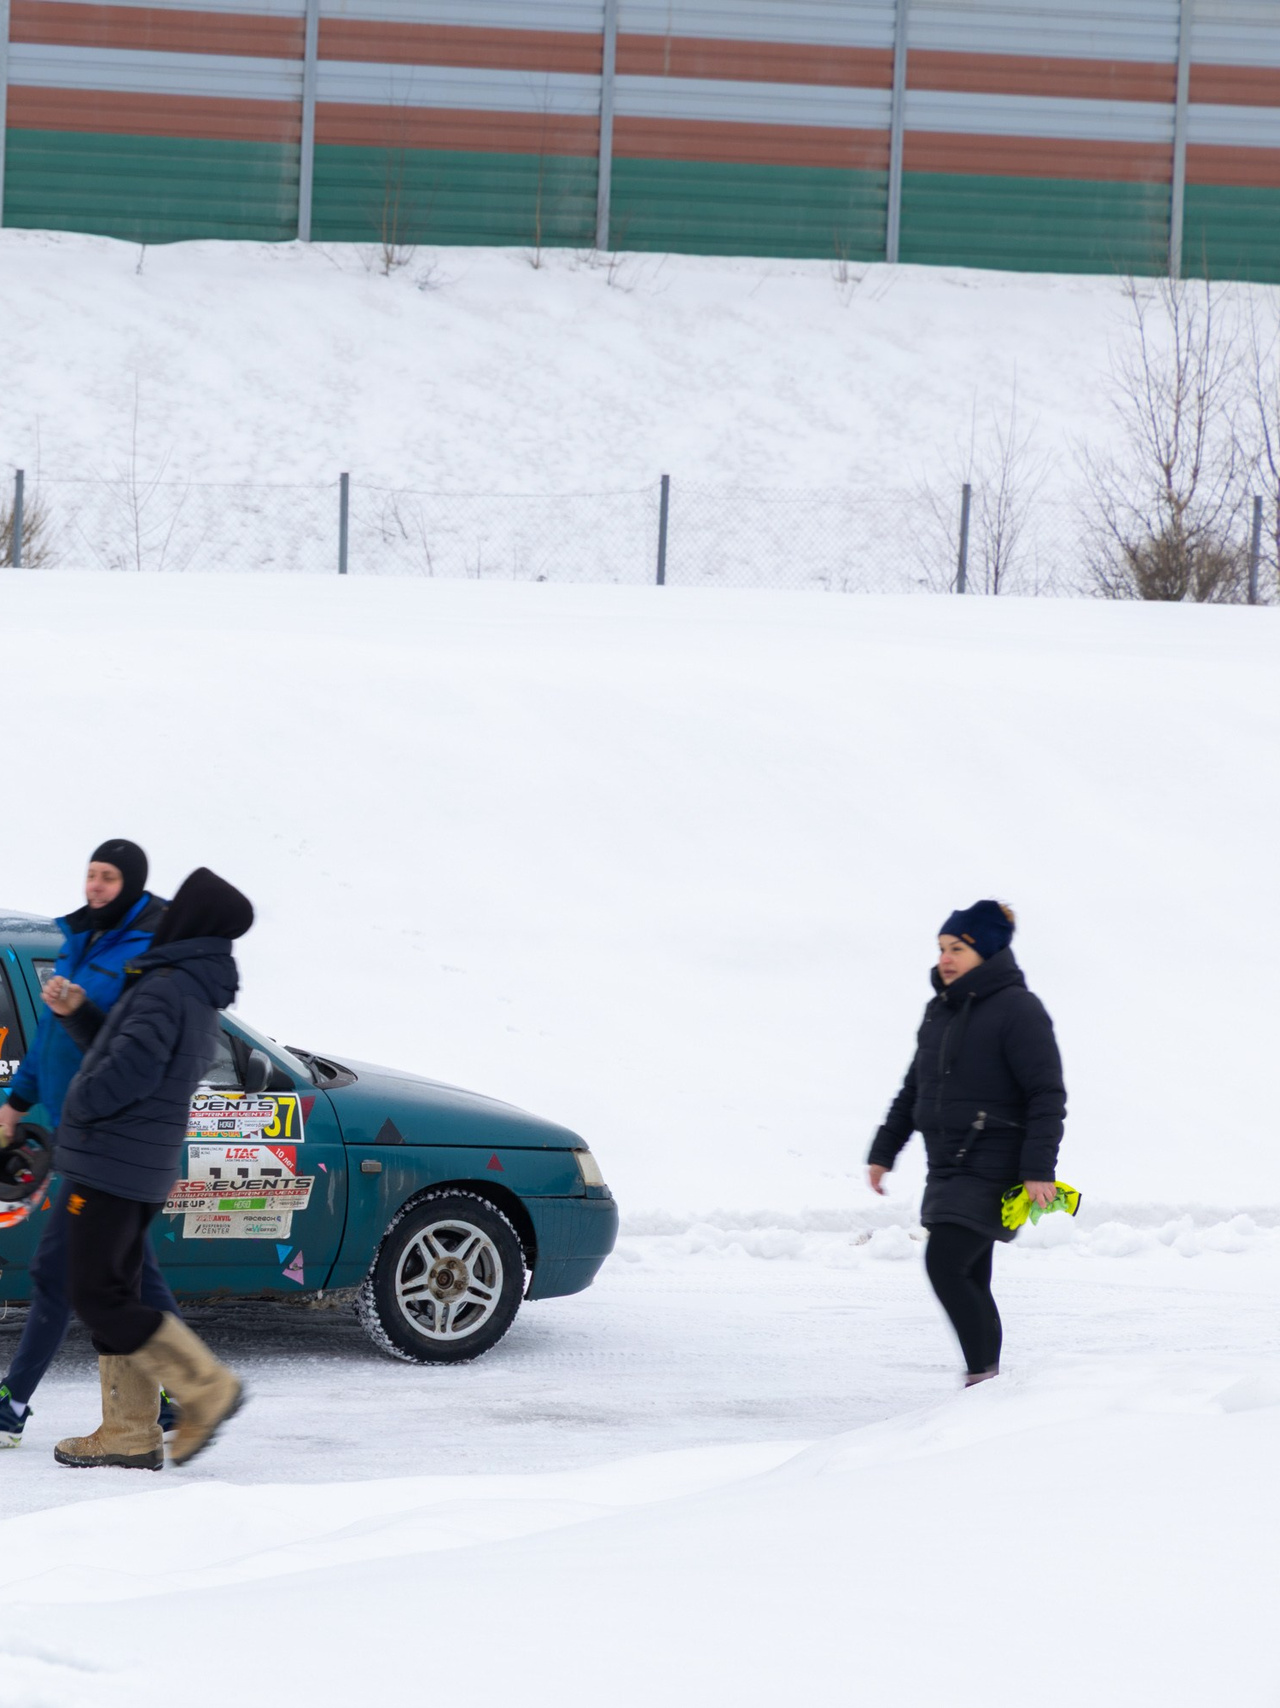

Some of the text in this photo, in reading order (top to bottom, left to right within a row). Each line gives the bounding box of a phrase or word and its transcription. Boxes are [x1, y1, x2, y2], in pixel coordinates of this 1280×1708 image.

[190, 1101, 274, 1111] VENTS
[225, 1148, 260, 1159] LTAC
[275, 1148, 284, 1158] 10
[177, 1178, 312, 1192] RS EVENTS
